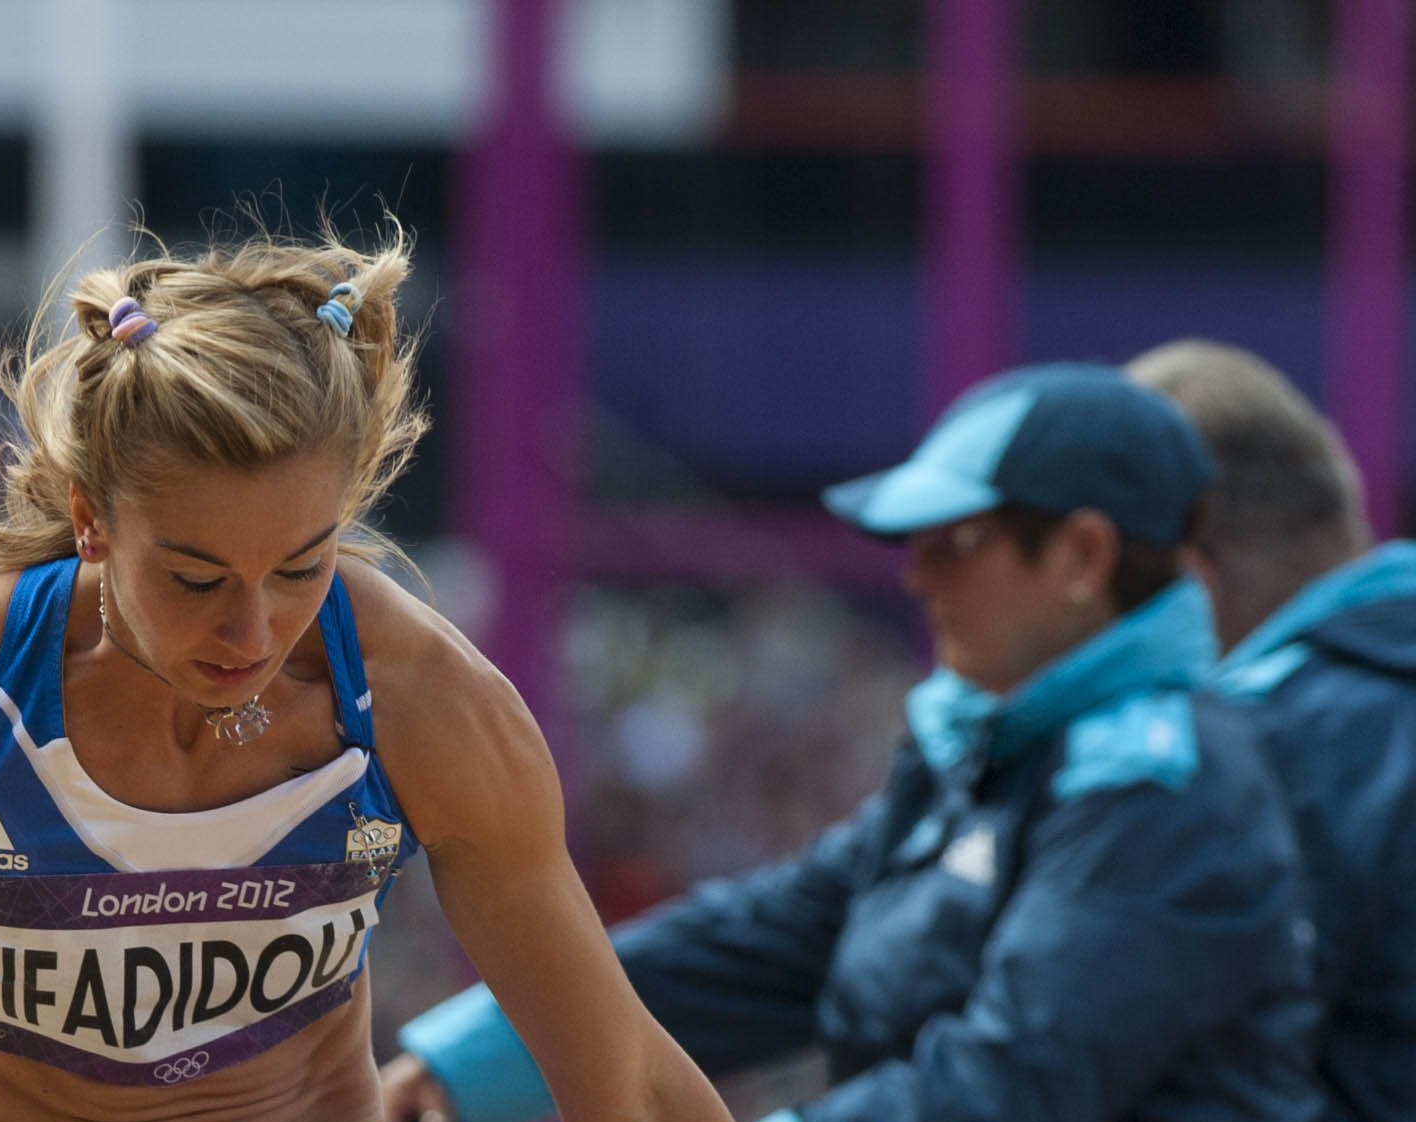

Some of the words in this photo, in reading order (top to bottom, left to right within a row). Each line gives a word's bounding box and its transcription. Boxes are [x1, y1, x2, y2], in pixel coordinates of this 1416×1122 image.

[82, 881, 207, 917] London
[216, 879, 295, 910] 2012
[0, 908, 366, 1049] IFADIDOU
